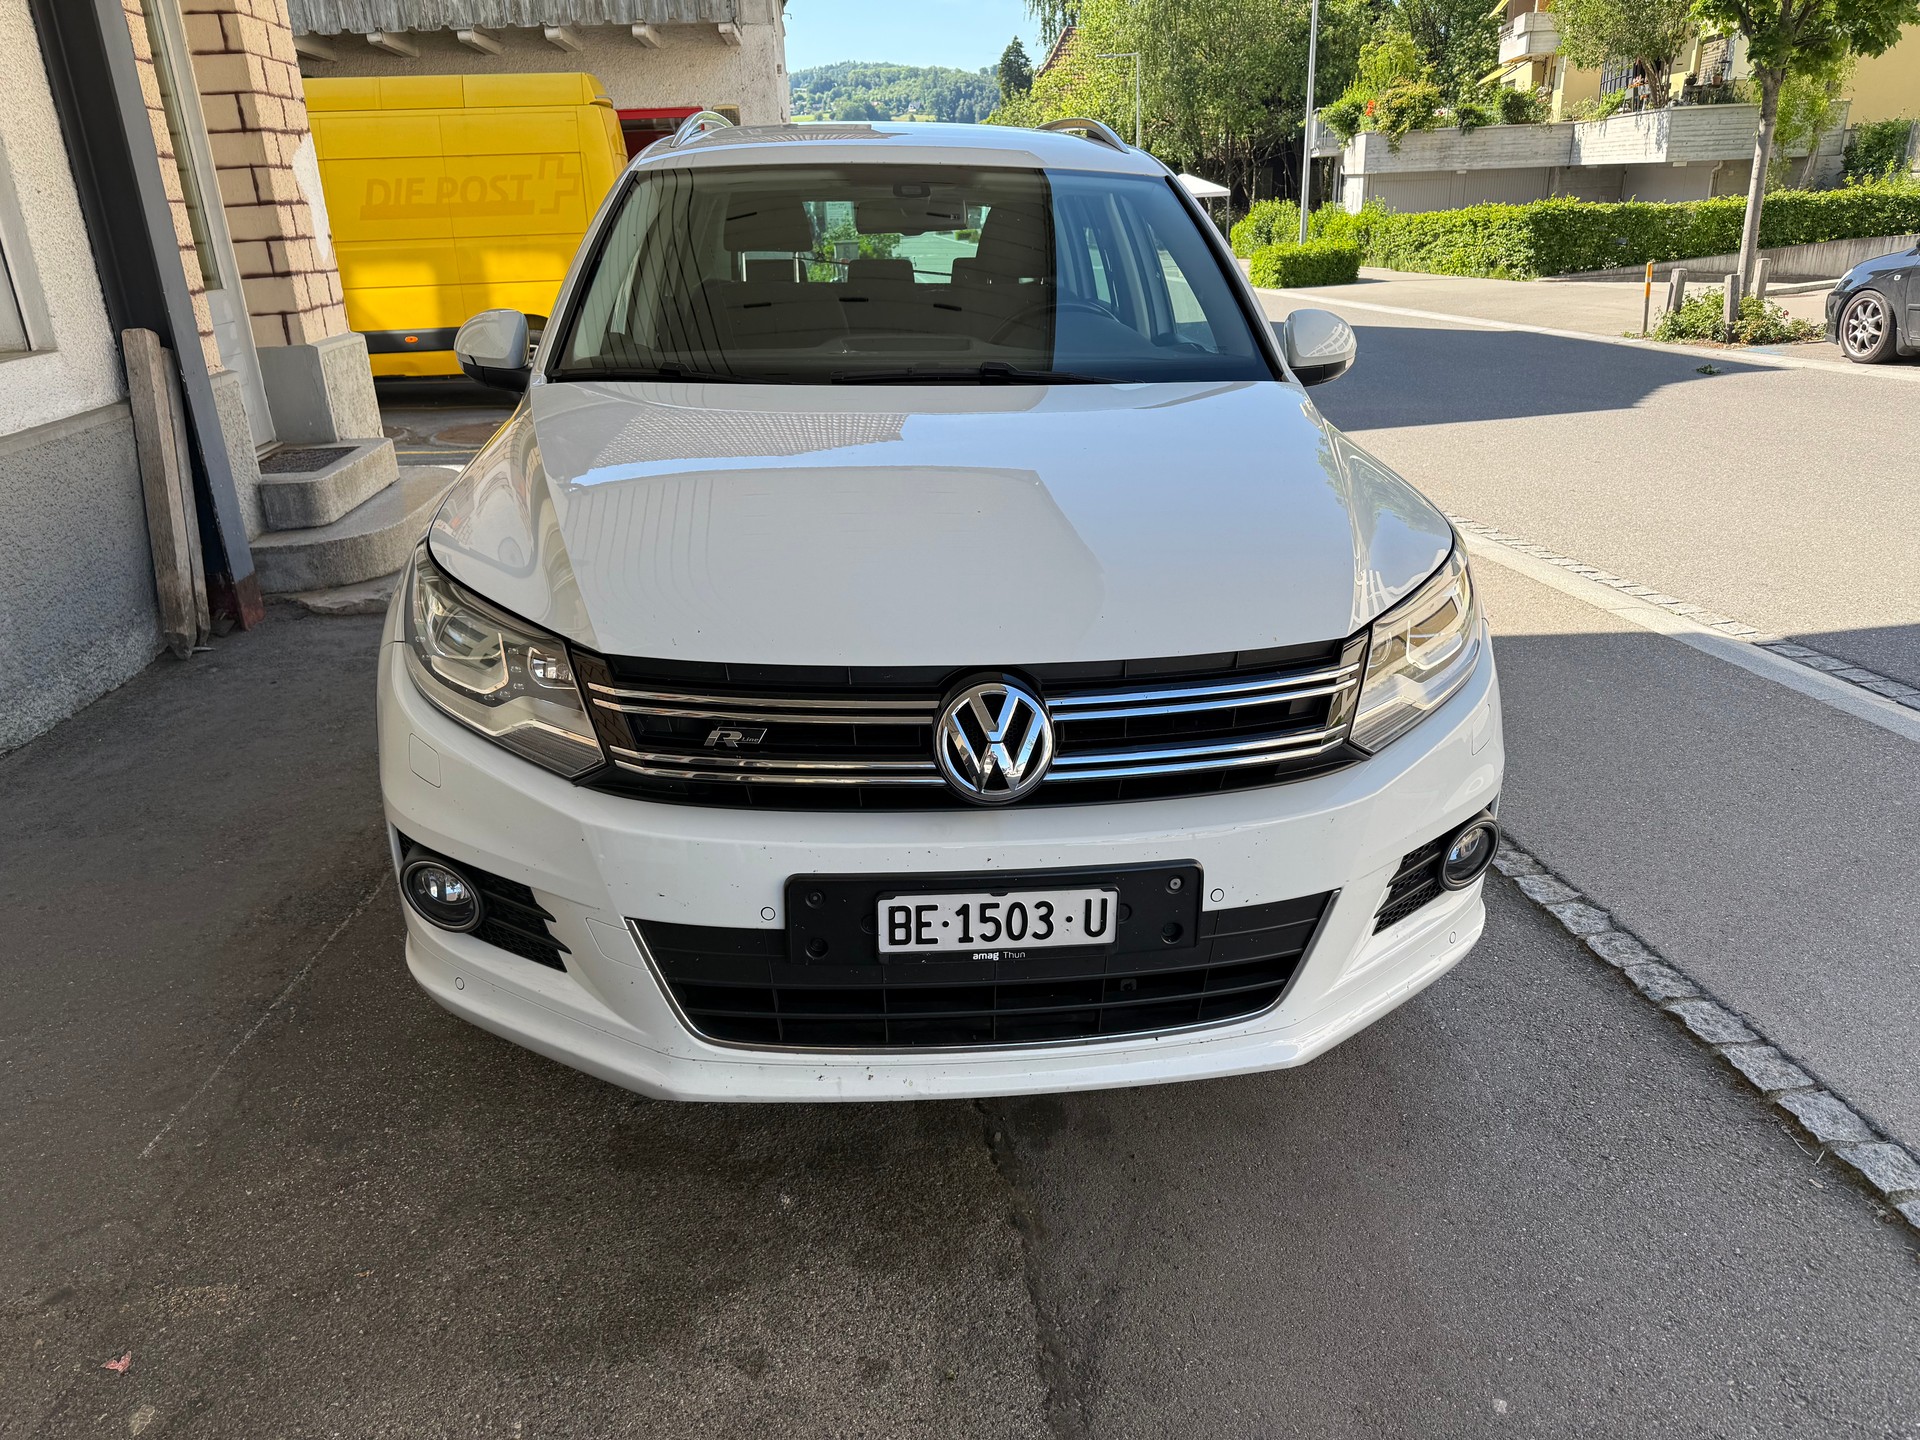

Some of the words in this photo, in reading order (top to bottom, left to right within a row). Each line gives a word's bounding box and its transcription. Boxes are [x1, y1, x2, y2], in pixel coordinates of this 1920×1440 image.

[365, 177, 426, 206] DIE
[436, 174, 533, 204] POST
[972, 952, 999, 961] amag
[1003, 951, 1026, 959] Thun
